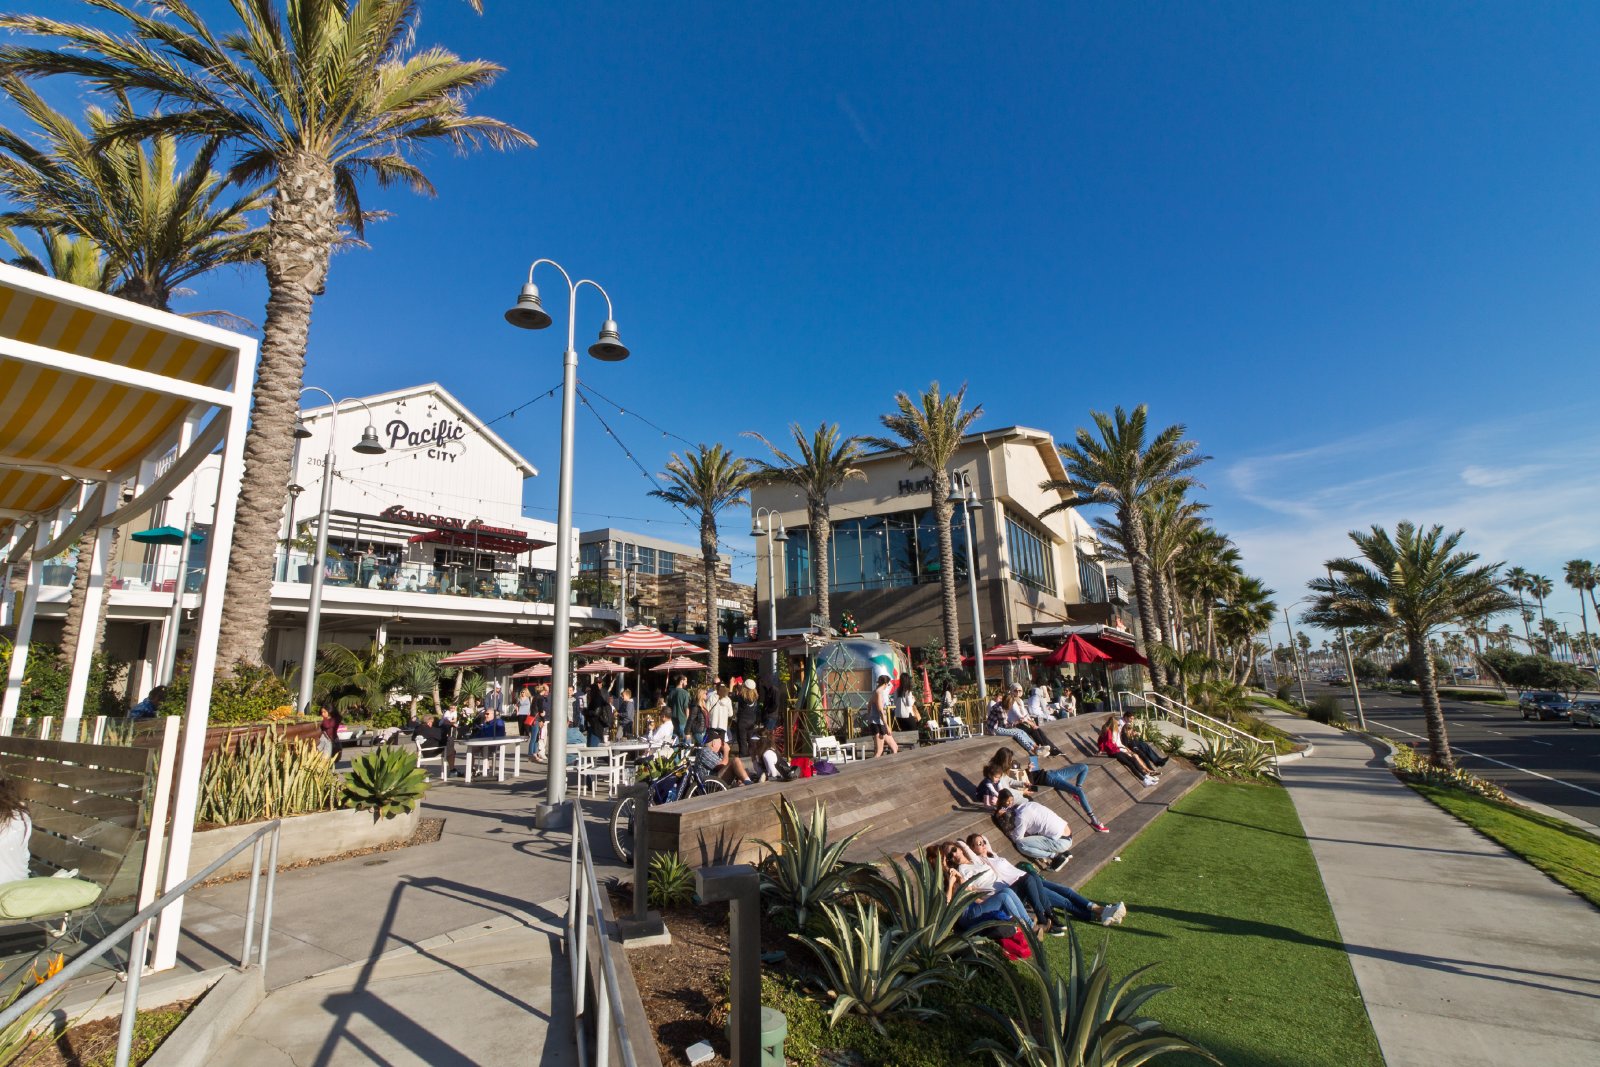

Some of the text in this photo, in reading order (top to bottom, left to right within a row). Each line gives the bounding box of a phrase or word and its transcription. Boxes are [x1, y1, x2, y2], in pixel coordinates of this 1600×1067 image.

[385, 419, 466, 449] Pacific
[427, 449, 457, 463] CITY
[399, 509, 428, 523] OLD
[427, 514, 467, 529] CROW
